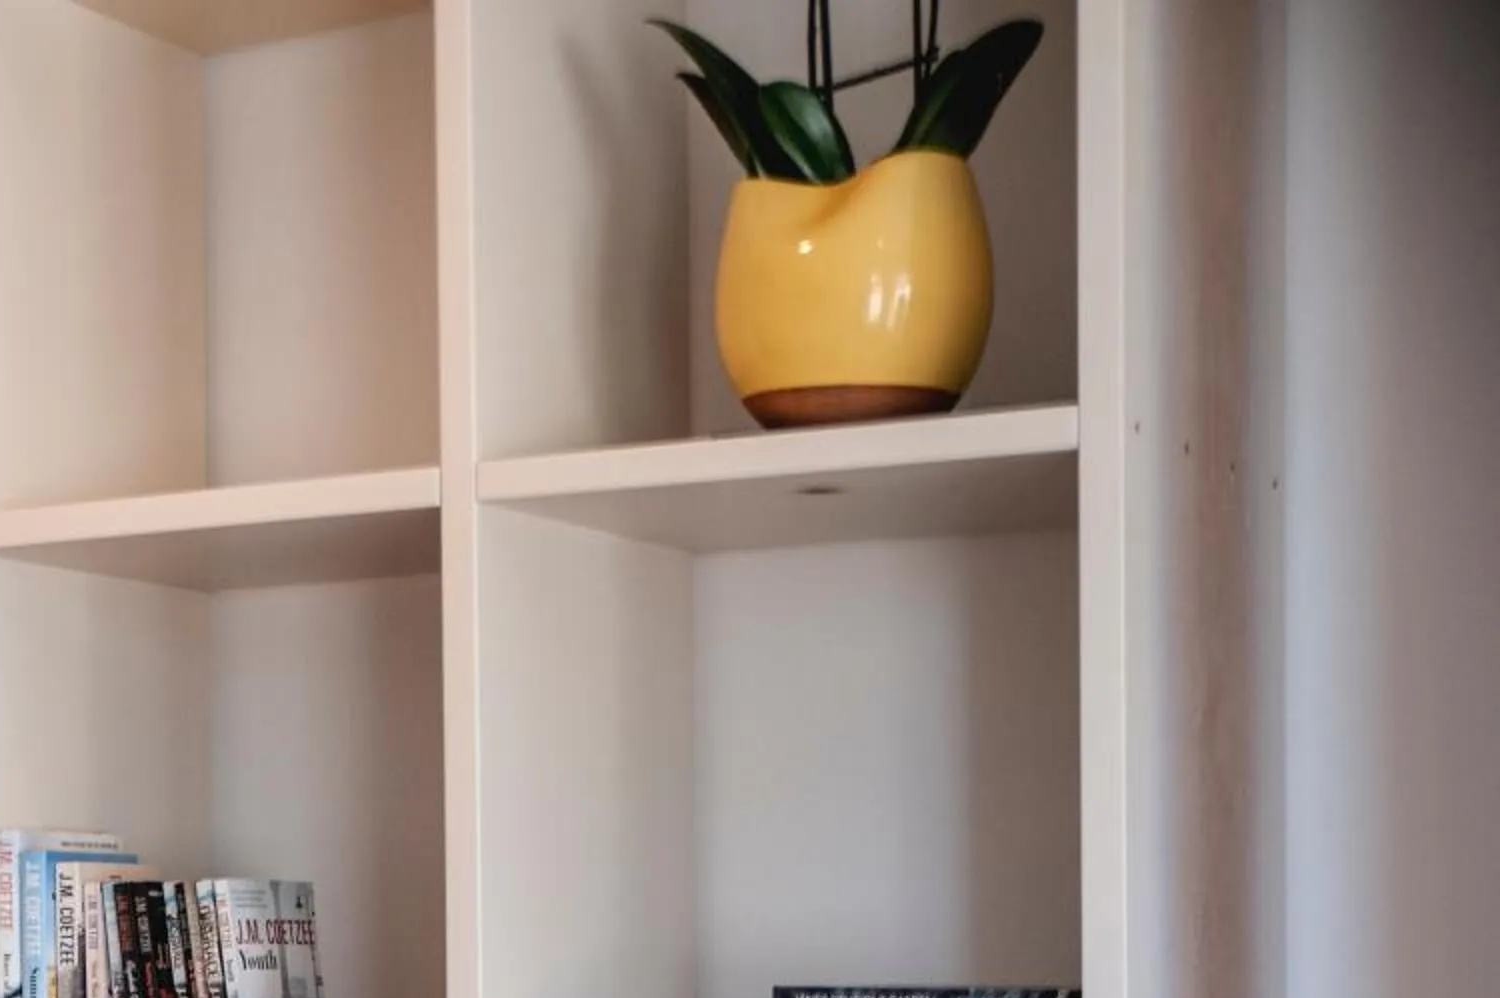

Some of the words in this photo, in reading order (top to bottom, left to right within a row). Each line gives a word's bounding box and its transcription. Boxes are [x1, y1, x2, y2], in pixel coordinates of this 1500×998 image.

[0, 870, 13, 930] COETZEE
[59, 873, 75, 901] J.M.
[26, 896, 41, 956] COETZEE
[59, 906, 75, 965] COETZEE
[236, 918, 264, 945] J.M.
[265, 918, 316, 946] COETZEE
[238, 948, 278, 971] Youth
